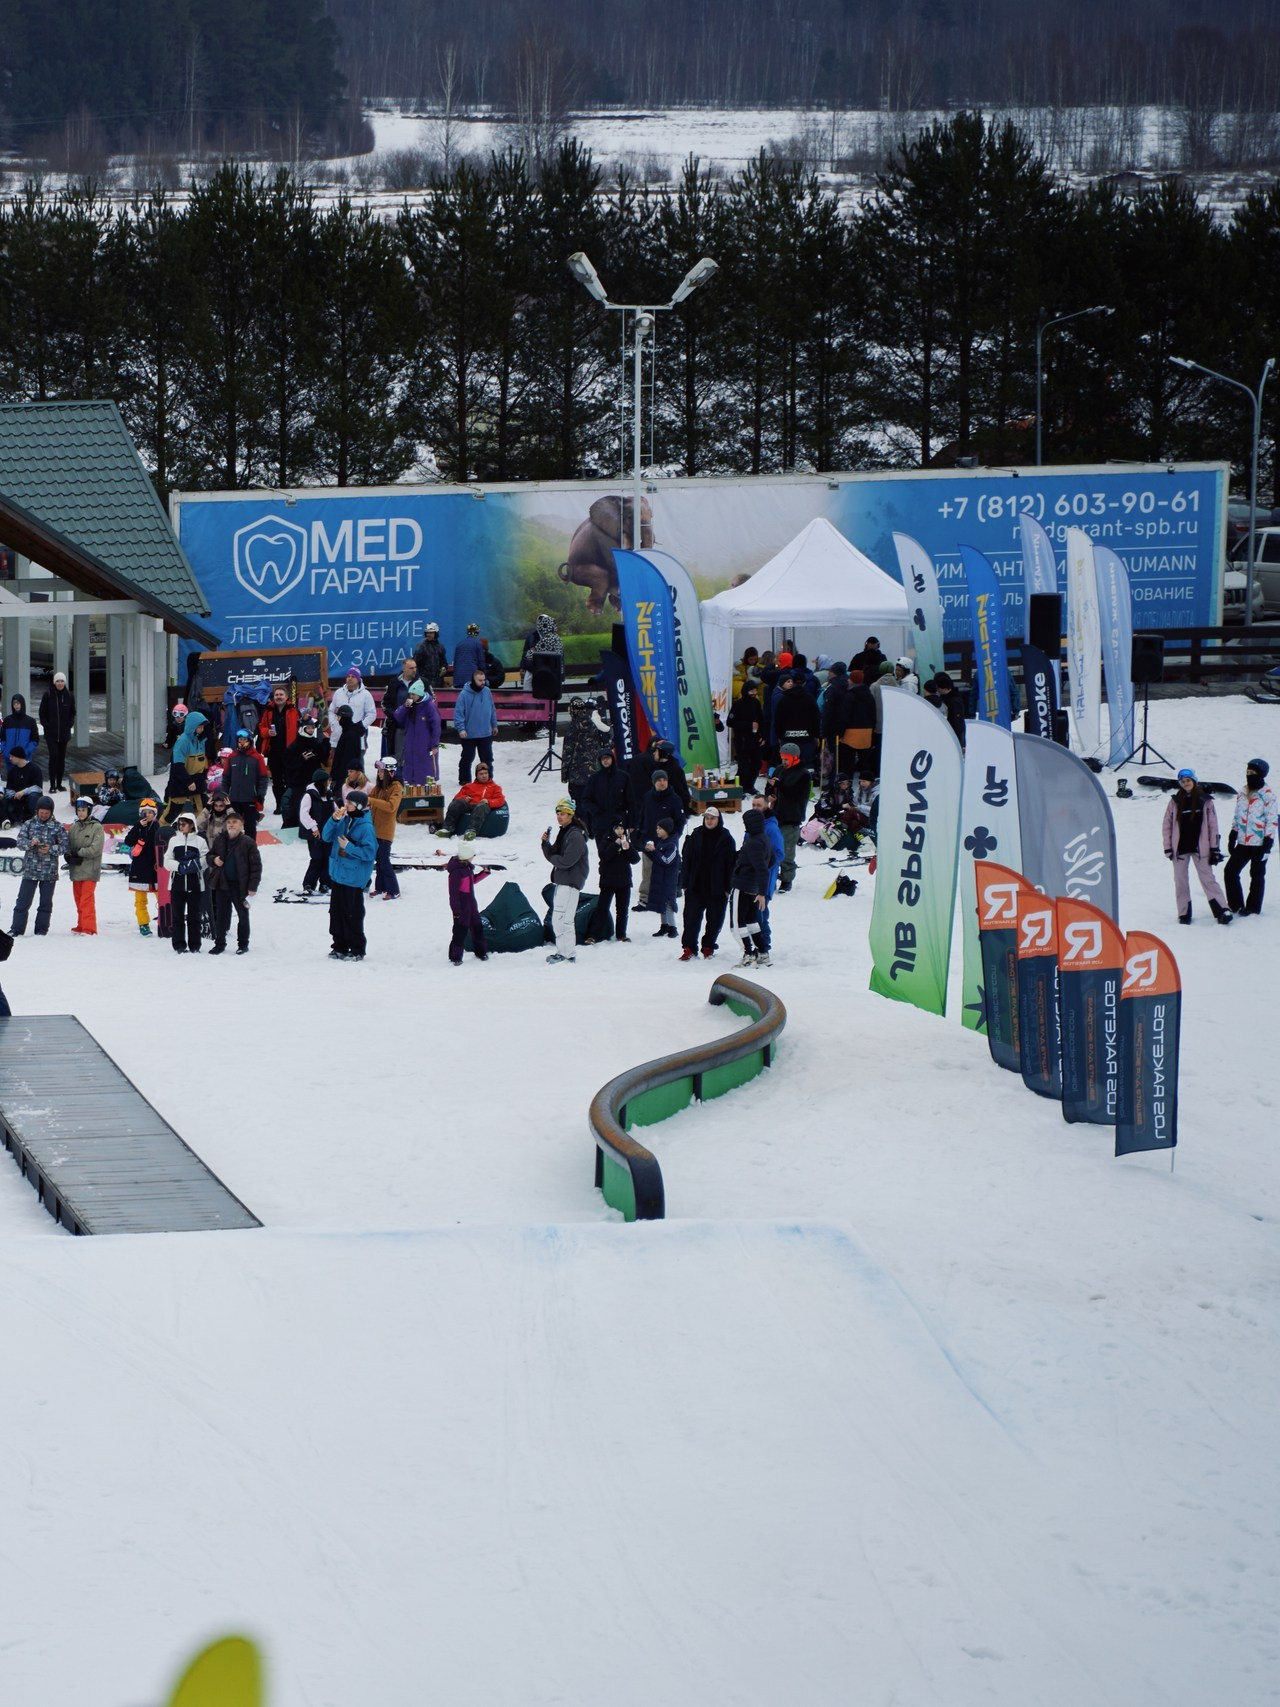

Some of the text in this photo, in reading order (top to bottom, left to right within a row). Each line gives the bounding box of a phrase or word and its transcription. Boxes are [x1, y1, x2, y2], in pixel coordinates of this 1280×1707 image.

[938, 490, 1199, 522] +7 (812) 603-90-61
[311, 518, 423, 564] MED
[310, 565, 420, 595] ГАРАНТ
[230, 620, 423, 644] ЛЕГКОЕ РЕШЕНИЕ
[227, 670, 292, 684] СНЕЖНЫЙ
[616, 678, 633, 760] invoke
[1034, 672, 1048, 739] nvoke
